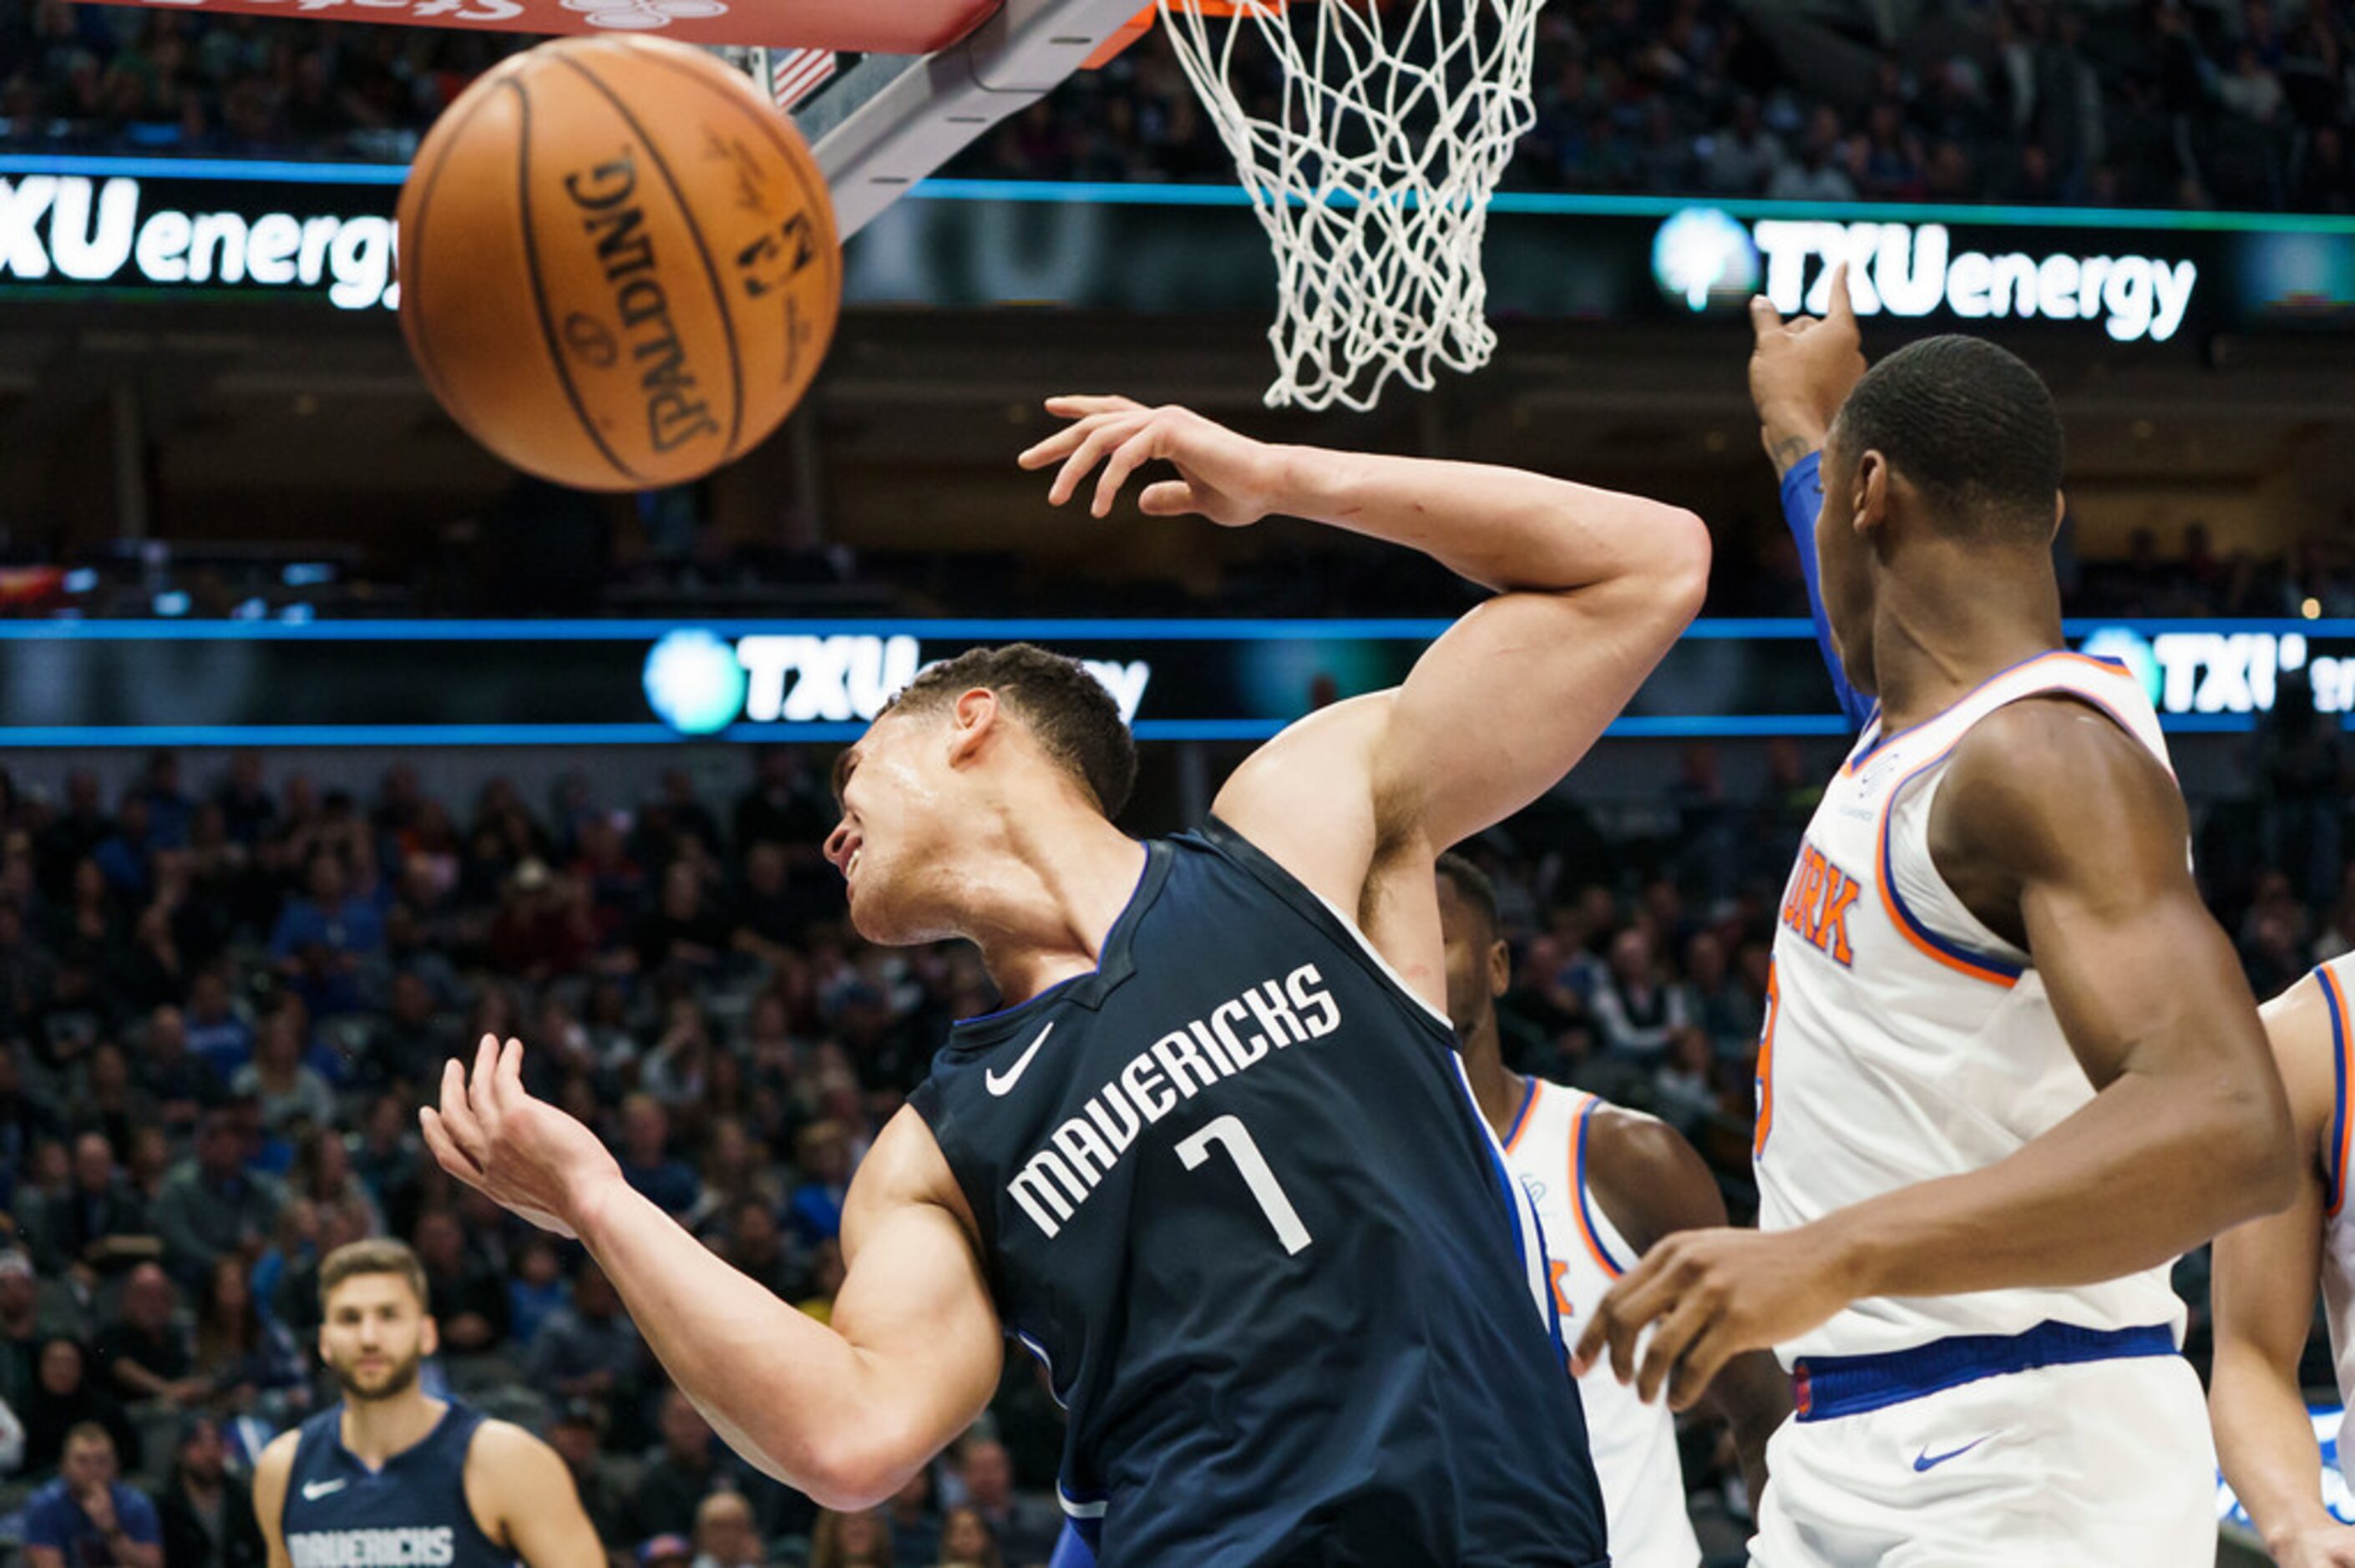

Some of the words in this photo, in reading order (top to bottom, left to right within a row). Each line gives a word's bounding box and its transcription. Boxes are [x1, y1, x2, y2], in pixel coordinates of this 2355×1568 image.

[564, 159, 721, 454] SPALDING
[1007, 963, 1340, 1239] MAVERICKS
[1174, 1114, 1312, 1256] 7
